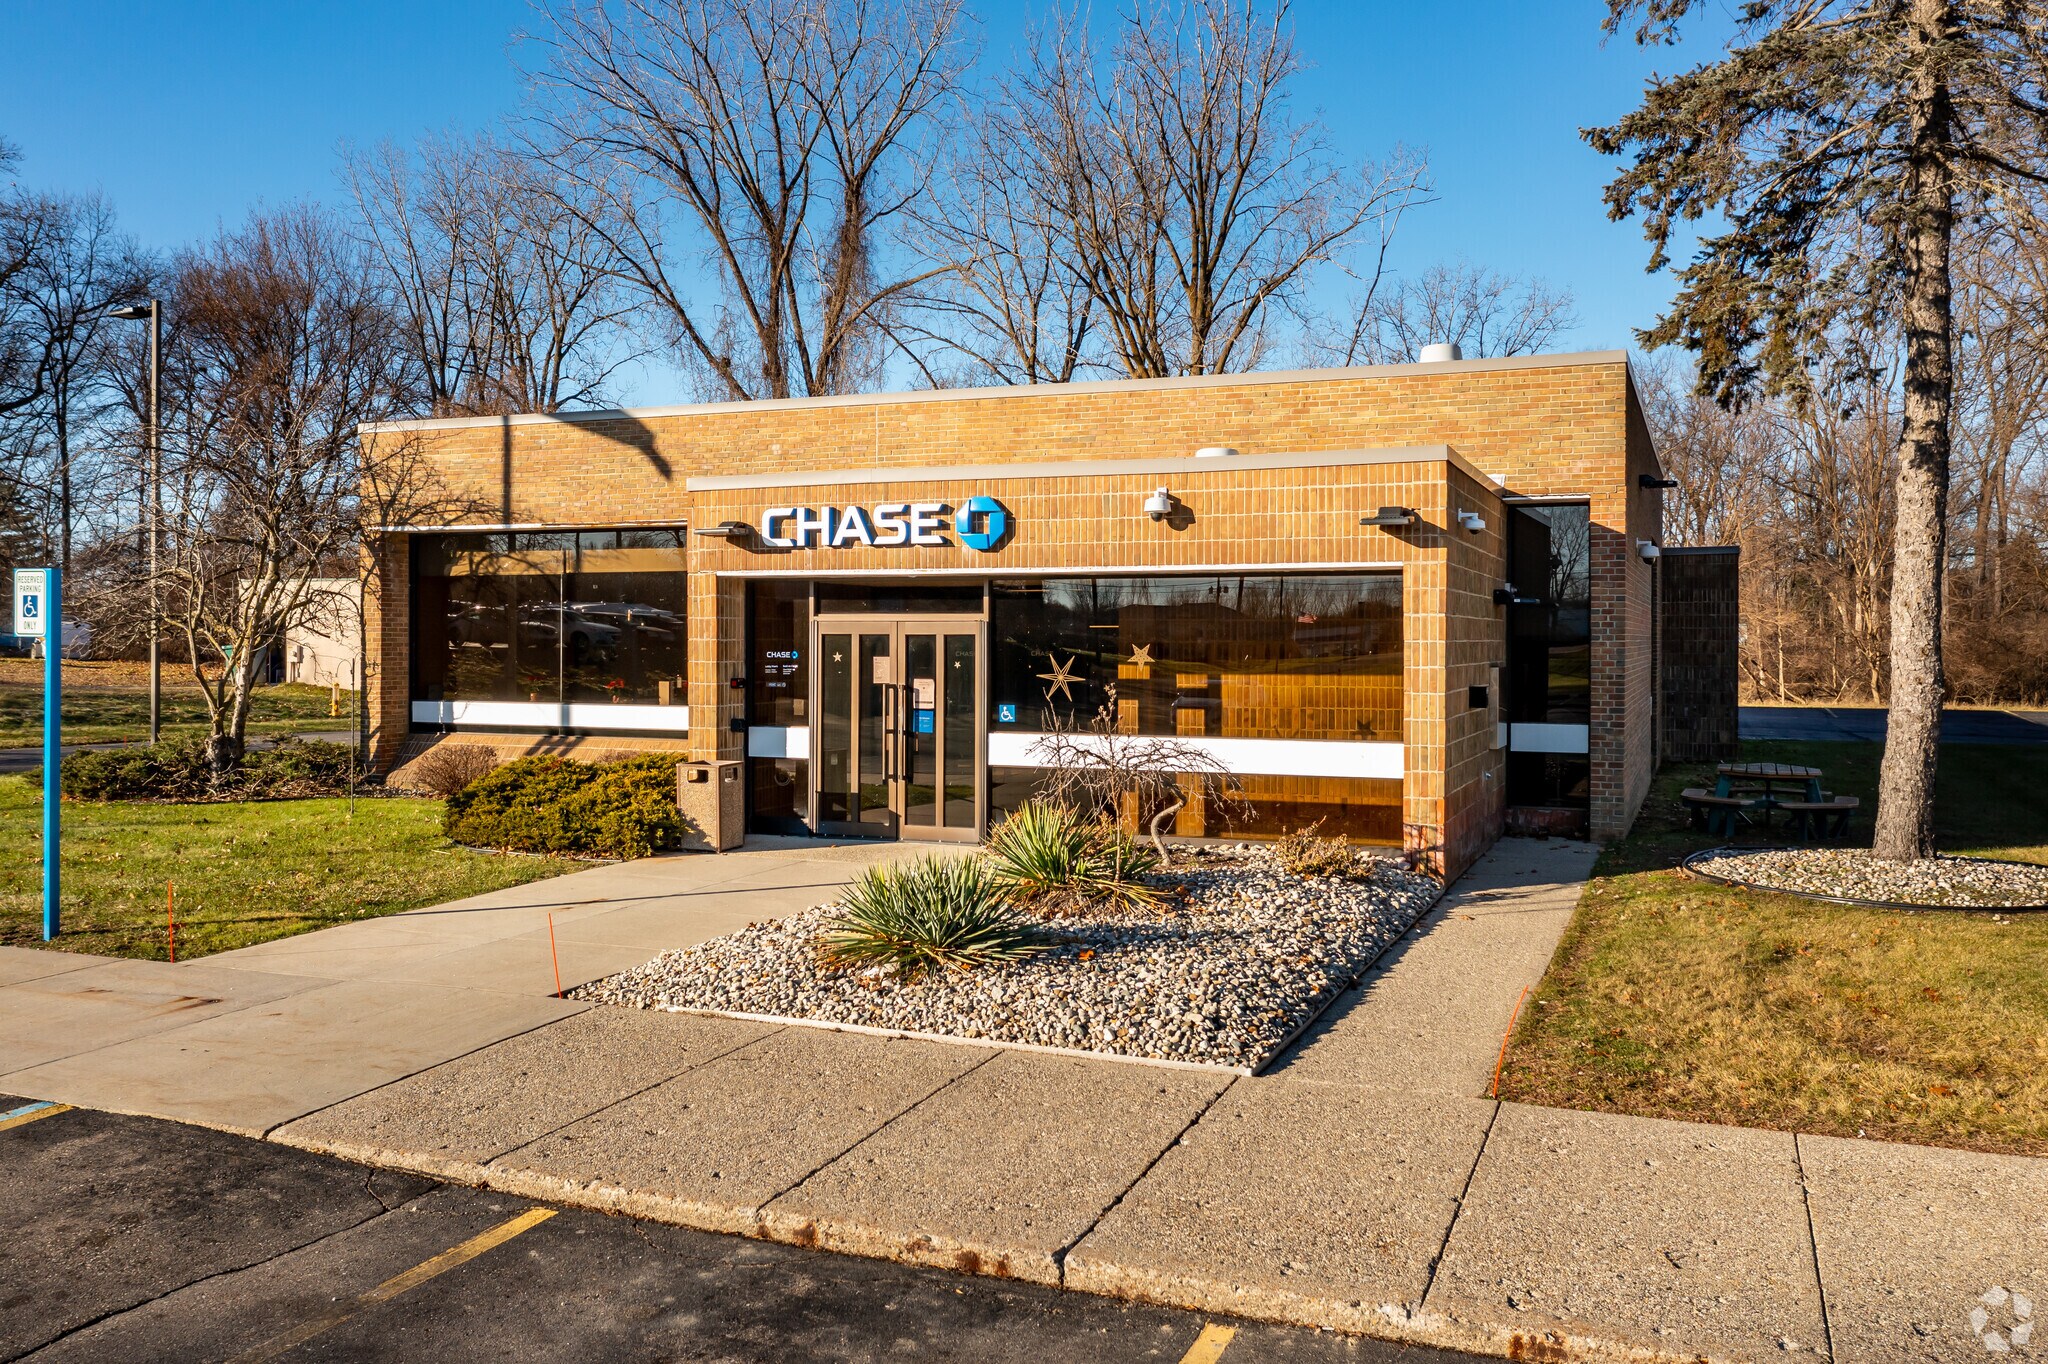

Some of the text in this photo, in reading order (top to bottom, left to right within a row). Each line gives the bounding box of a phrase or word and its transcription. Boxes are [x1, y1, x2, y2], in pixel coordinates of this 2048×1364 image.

[761, 503, 946, 548] CHASE
[18, 575, 43, 583] RESERVED
[23, 621, 36, 630] ONLY
